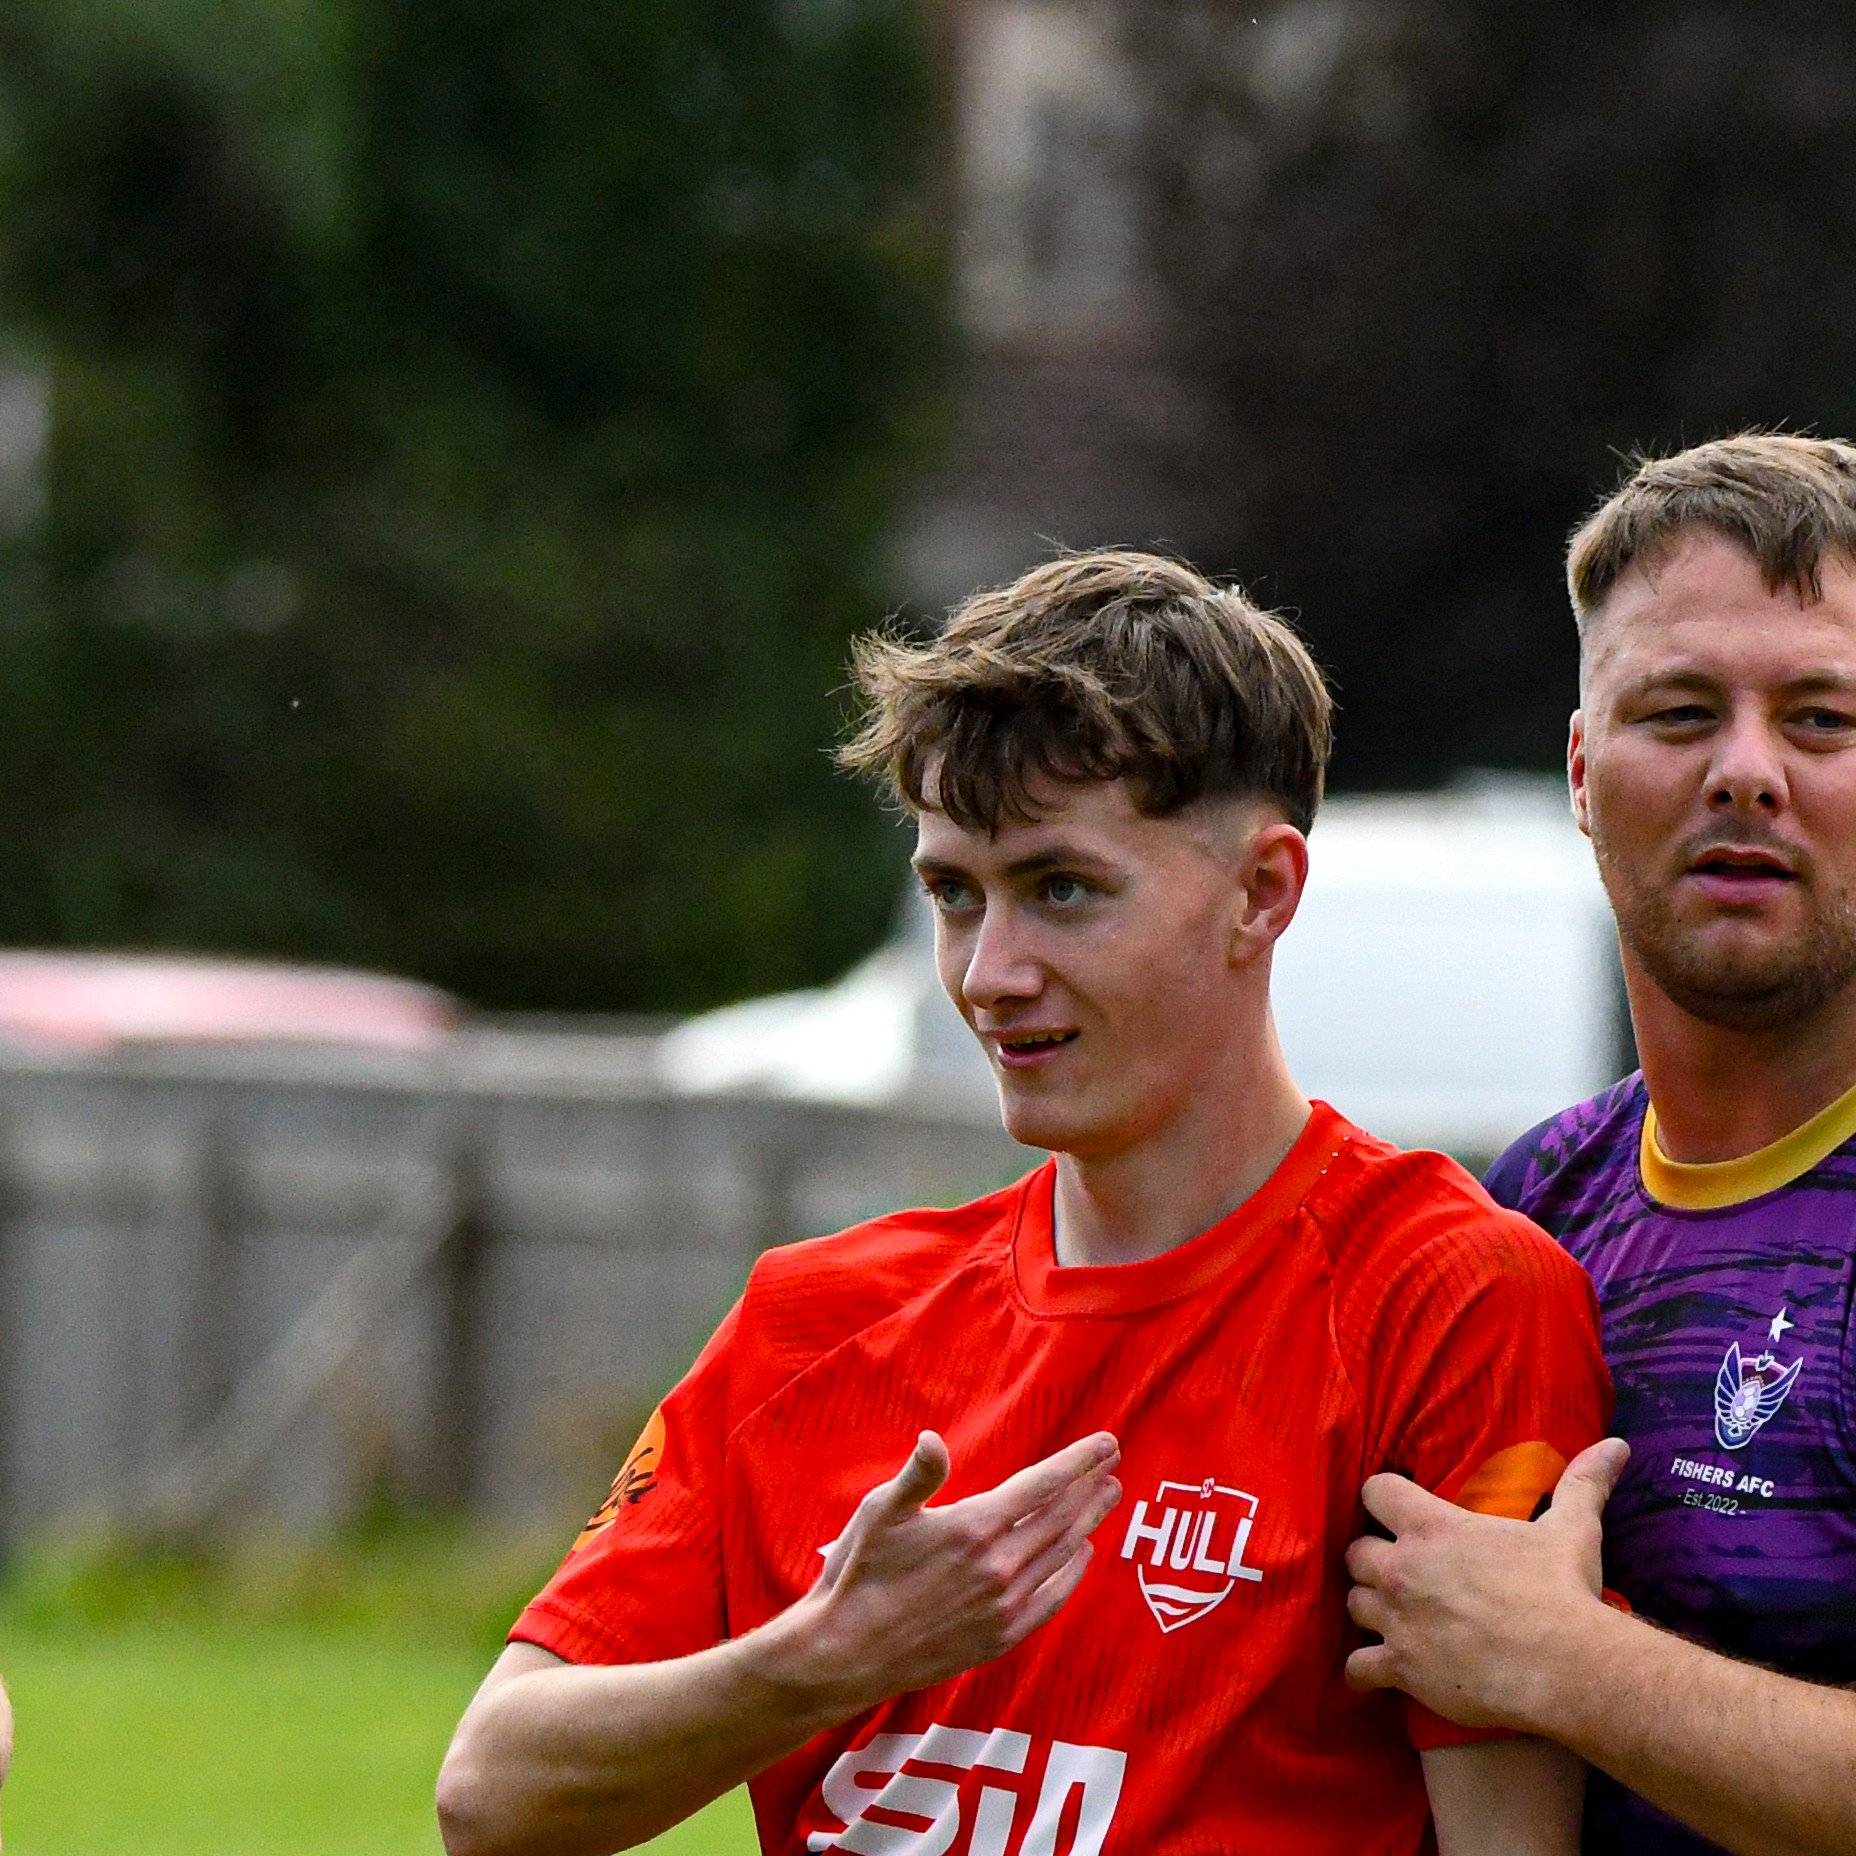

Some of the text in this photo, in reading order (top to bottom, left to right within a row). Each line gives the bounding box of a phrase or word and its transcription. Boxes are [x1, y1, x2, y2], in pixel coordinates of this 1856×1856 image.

[1670, 1457, 1775, 1498] FISHERS AFC
[1120, 1500, 1263, 1582] HULL
